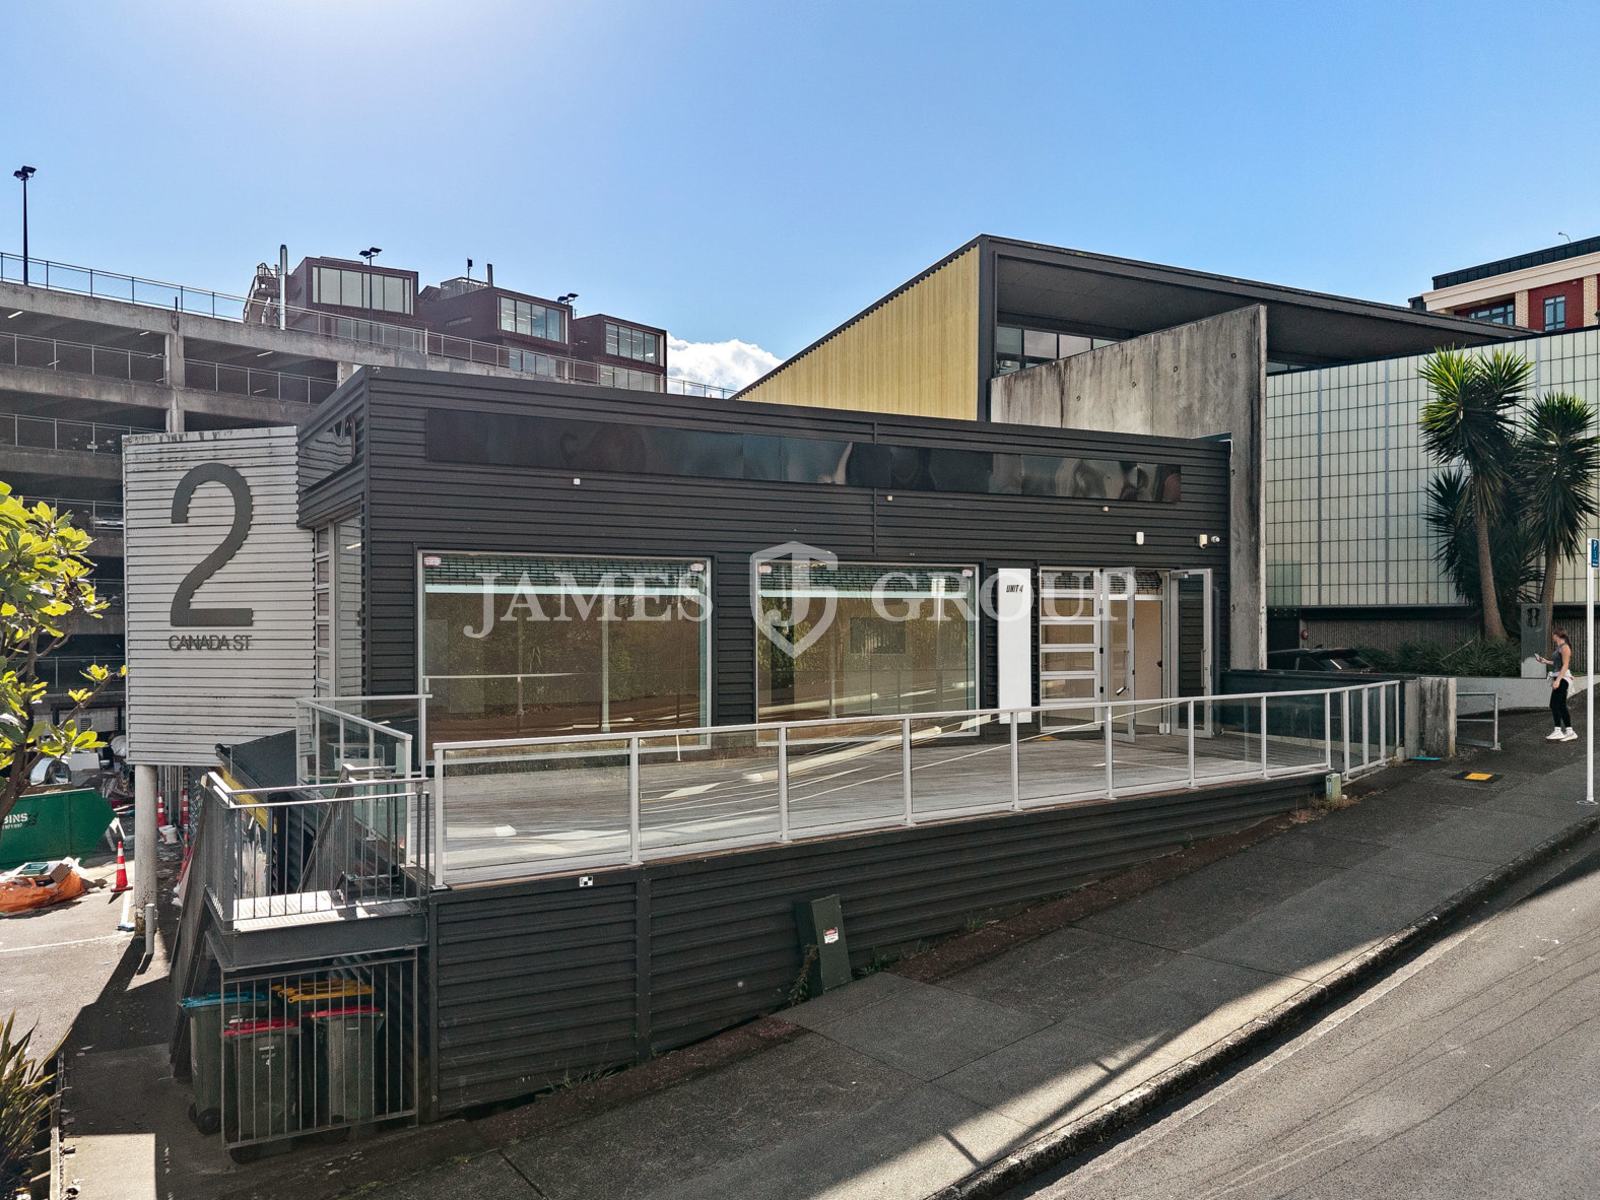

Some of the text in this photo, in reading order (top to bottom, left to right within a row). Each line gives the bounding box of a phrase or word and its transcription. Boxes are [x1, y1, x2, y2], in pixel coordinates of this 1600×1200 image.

[170, 462, 253, 626] 2
[1006, 584, 1024, 593] UNIT 4
[168, 634, 253, 651] CANADA ST
